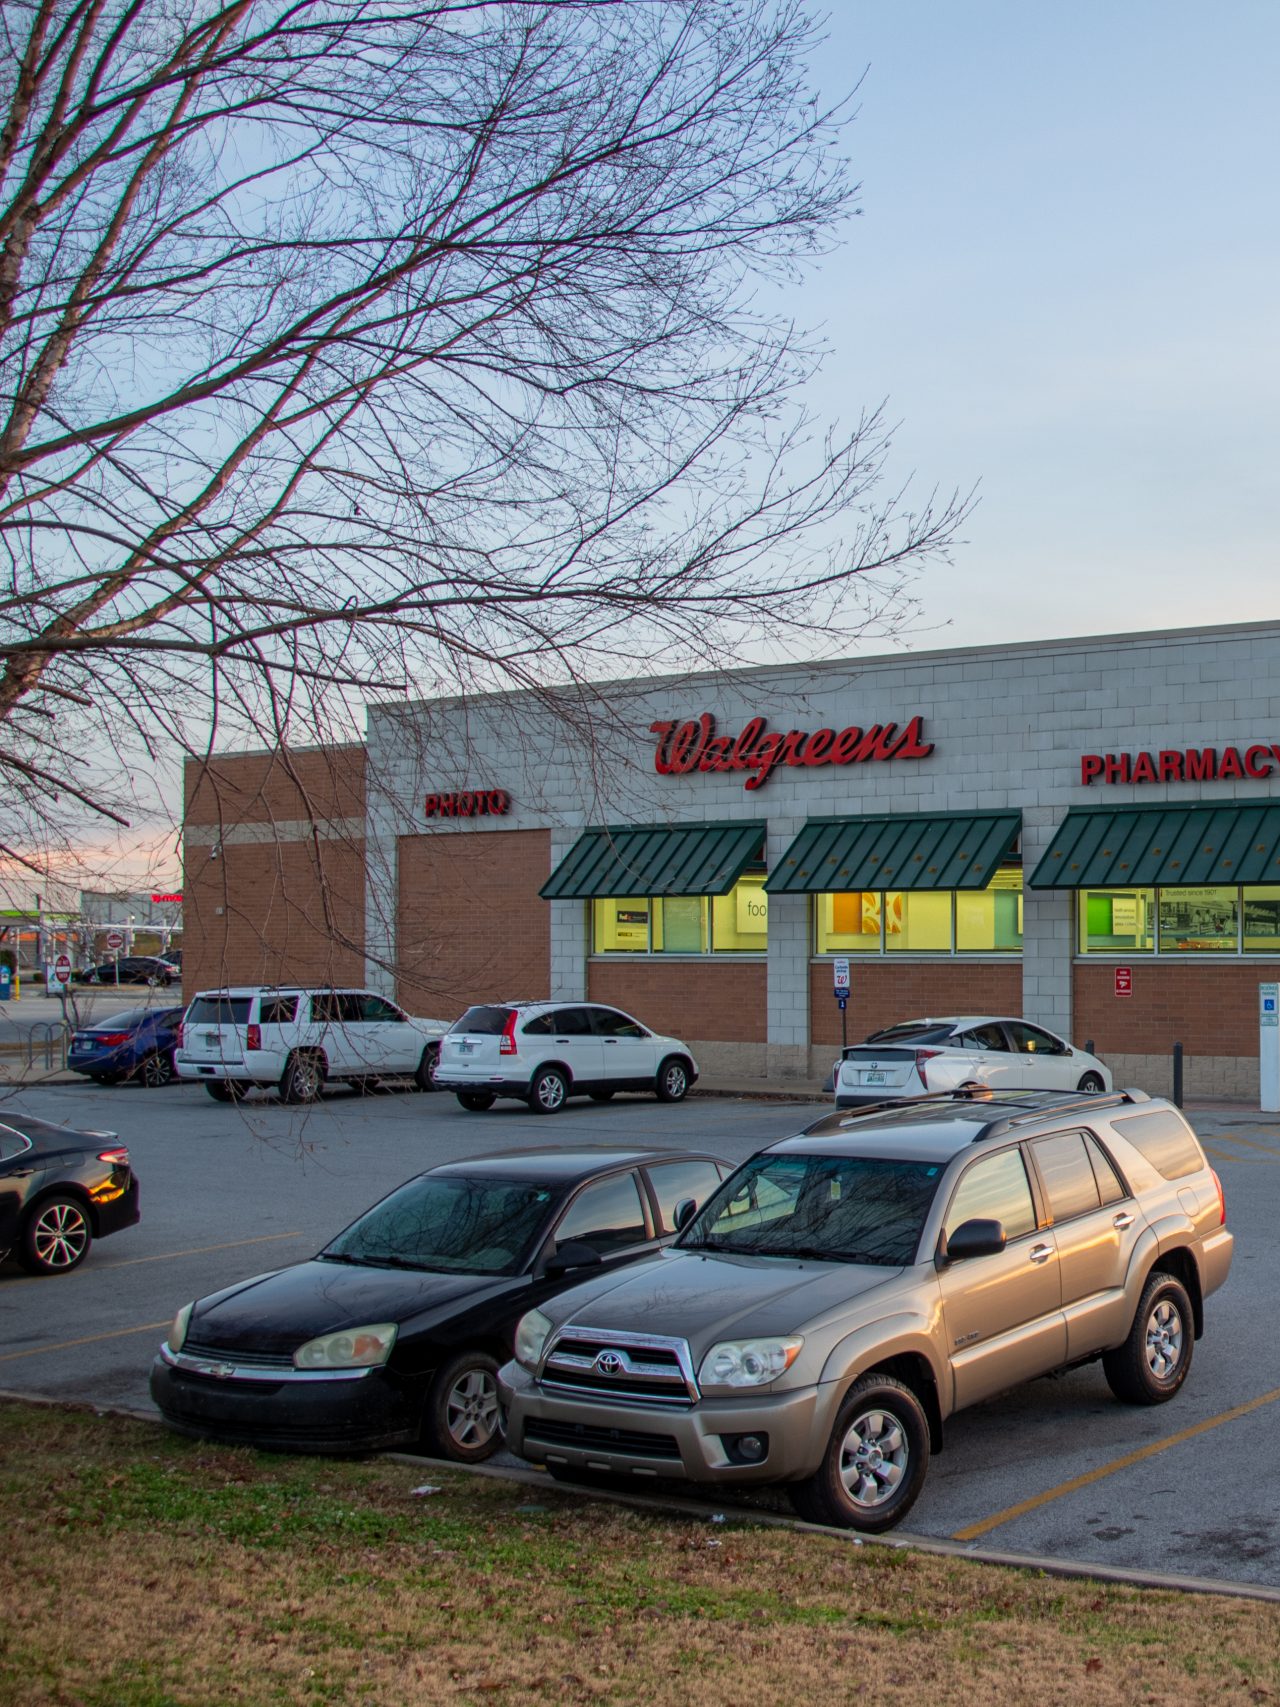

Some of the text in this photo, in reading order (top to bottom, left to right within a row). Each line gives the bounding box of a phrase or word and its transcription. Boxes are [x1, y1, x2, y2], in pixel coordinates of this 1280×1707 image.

[649, 711, 934, 790] Walgreens
[425, 788, 509, 818] PHOTO
[1165, 889, 1187, 897] Trusted
